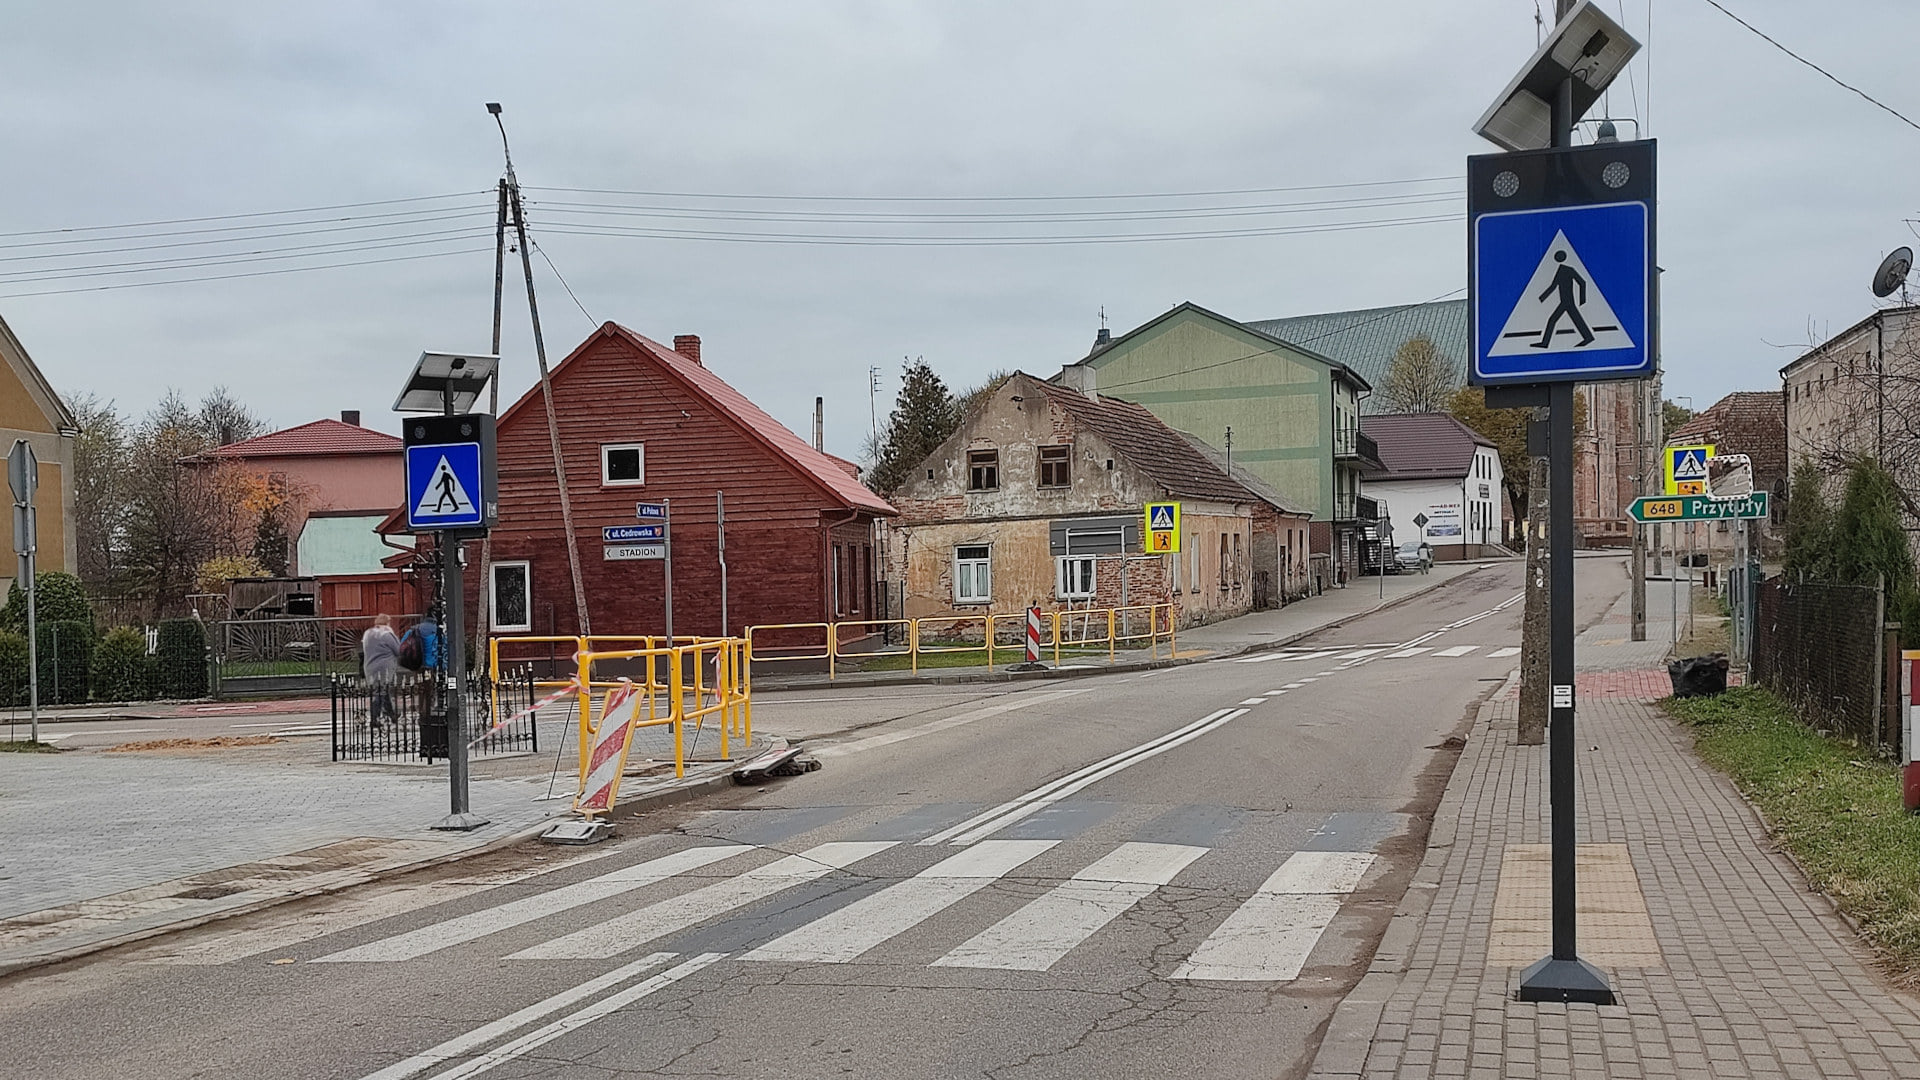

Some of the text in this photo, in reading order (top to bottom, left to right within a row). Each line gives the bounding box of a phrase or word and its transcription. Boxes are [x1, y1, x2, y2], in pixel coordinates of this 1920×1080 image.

[1650, 503, 1675, 515] 648
[1692, 498, 1763, 517] Przytuły
[620, 528, 653, 538] Cedrowska
[619, 548, 656, 557] STADION
